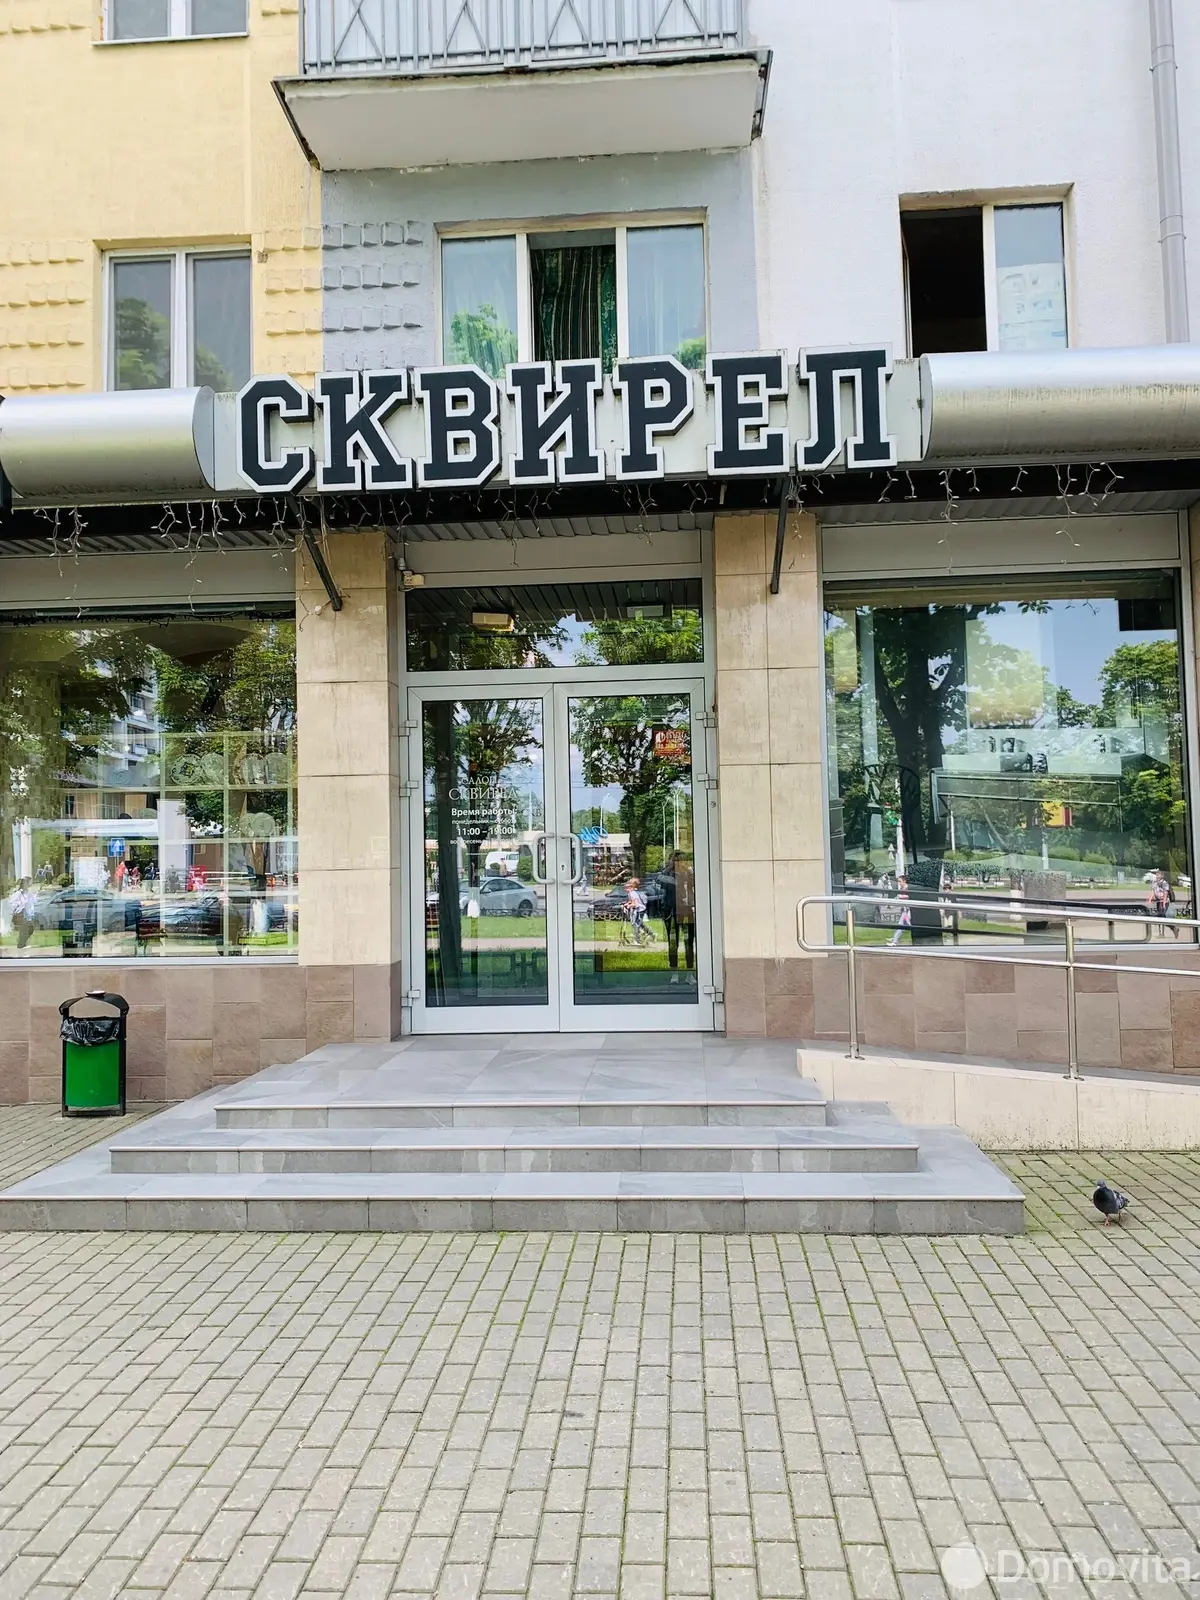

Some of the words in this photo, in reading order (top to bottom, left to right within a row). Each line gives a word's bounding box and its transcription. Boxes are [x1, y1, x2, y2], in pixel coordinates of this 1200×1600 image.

[236, 342, 898, 493] СКВИРЕЛ
[451, 808, 480, 818] Время
[481, 807, 517, 817] работы:
[457, 827, 480, 836] 11:00
[490, 826, 513, 836] 19:00
